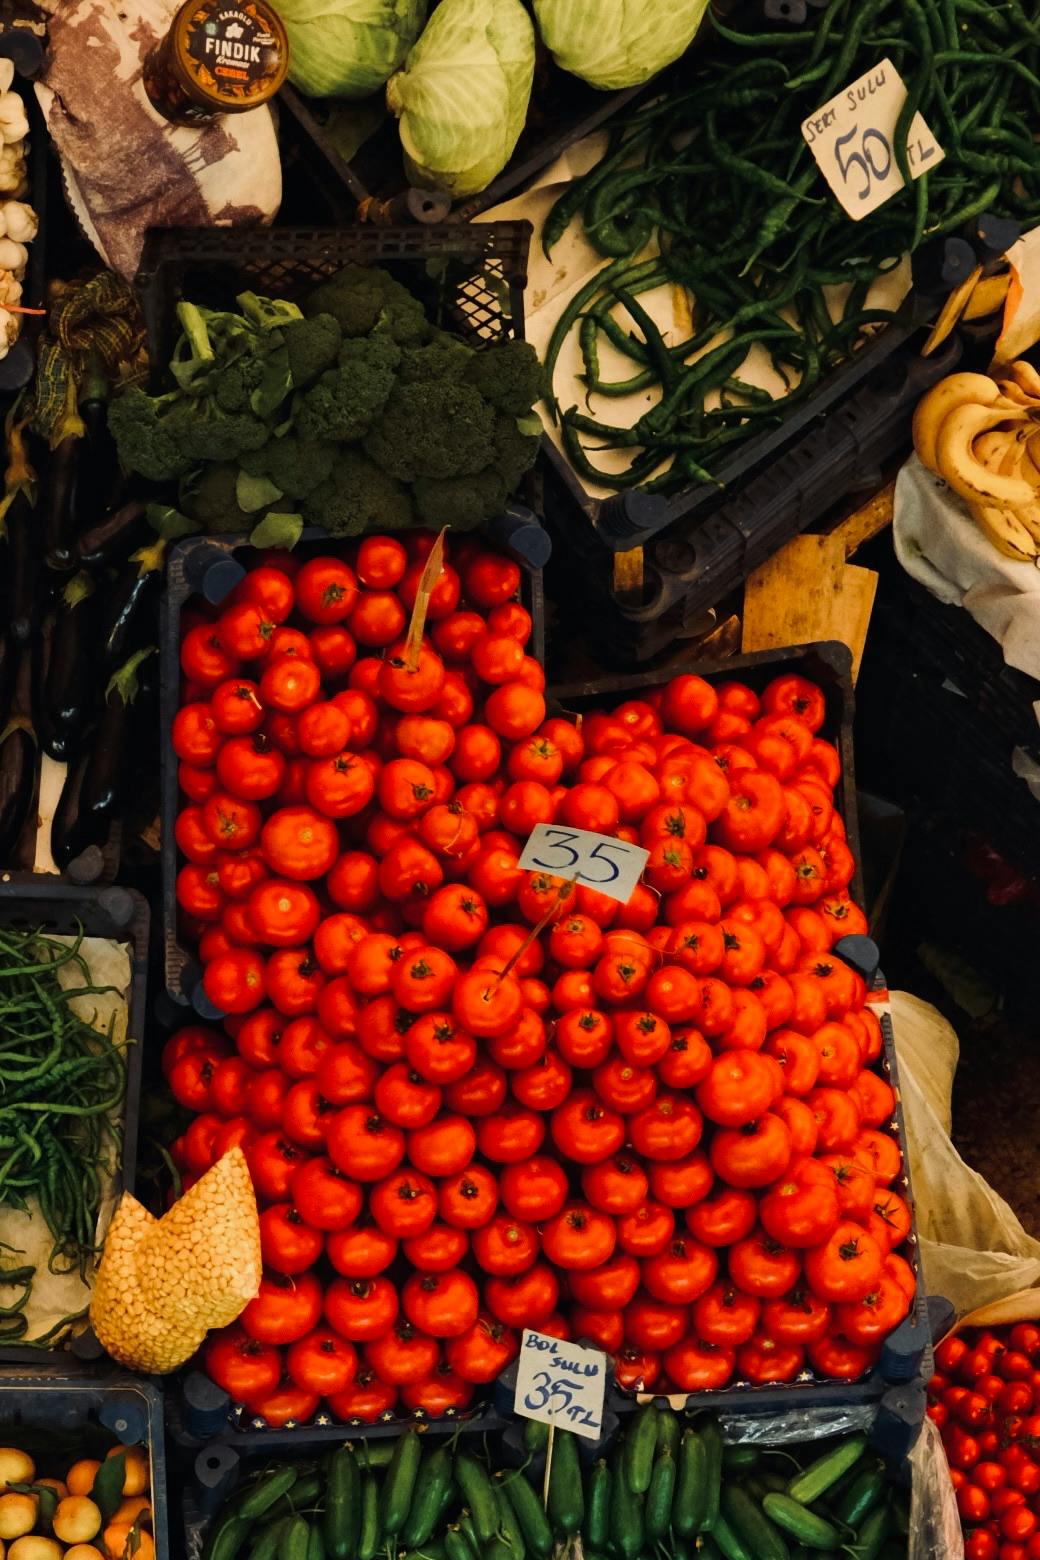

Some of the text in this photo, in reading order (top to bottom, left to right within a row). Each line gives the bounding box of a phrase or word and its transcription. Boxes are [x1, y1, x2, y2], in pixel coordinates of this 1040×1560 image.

[205, 38, 260, 63] FINDIK
[806, 69, 886, 143] SERT SULU
[834, 123, 935, 200] 50 TL
[532, 829, 632, 883] 35
[525, 1334, 559, 1354] BOL
[549, 1357, 599, 1377] SULU
[524, 1371, 600, 1428] 35 TL
